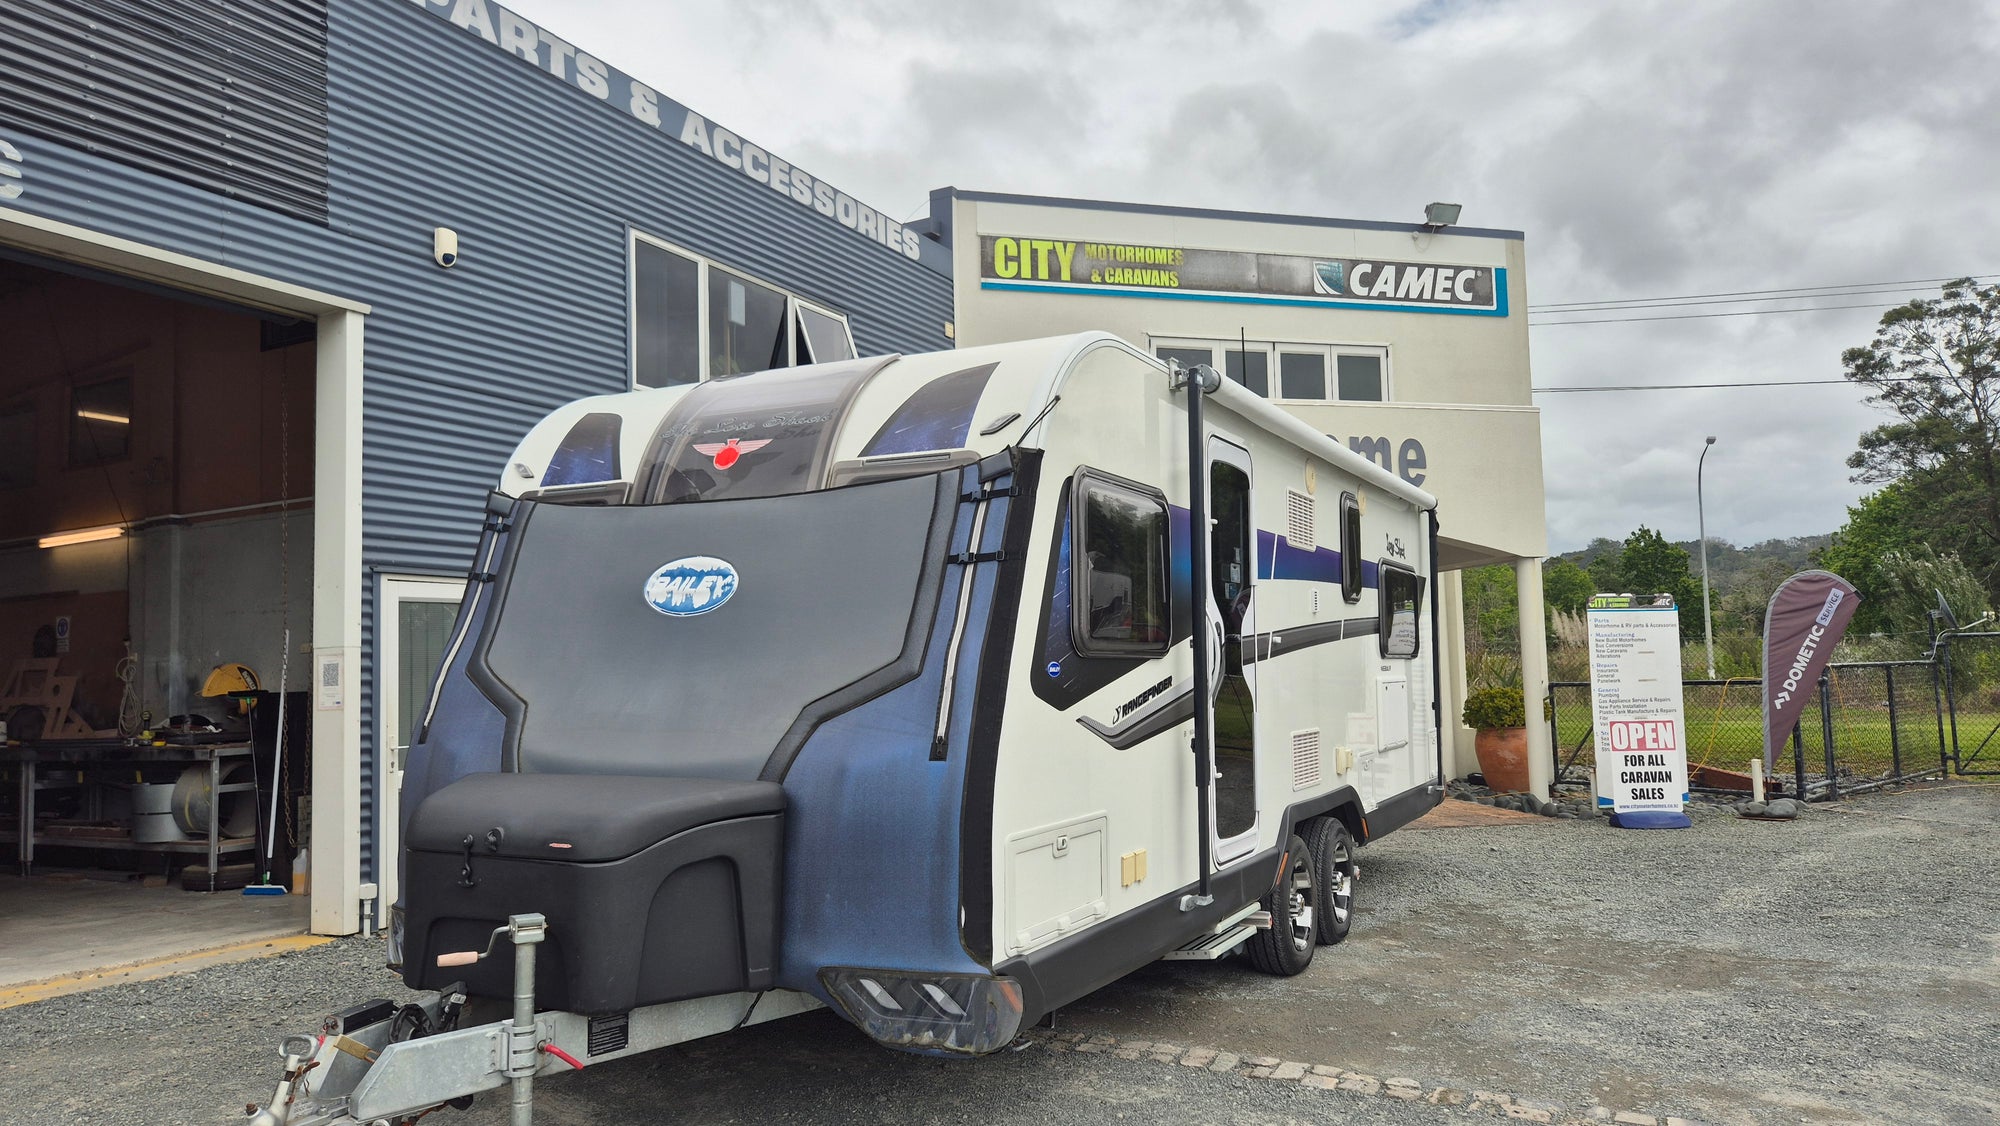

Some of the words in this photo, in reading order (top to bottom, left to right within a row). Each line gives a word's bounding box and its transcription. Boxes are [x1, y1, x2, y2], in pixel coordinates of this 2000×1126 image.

[412, 0, 609, 100] ARTS
[630, 80, 661, 128] &
[680, 110, 920, 261] ACCESSORIES
[994, 237, 1076, 281] CITY
[1085, 243, 1185, 266] MOTORHOMES
[1091, 269, 1102, 283] &
[1105, 268, 1179, 288] CARAVANS
[1350, 263, 1476, 302] CAMEC
[1782, 624, 1825, 692] DOMETIC
[1820, 592, 1840, 622] SERVICE
[1122, 675, 1173, 718] RANGEFINDER
[1611, 722, 1675, 750] OPEN
[1620, 771, 1672, 783] CARAVAN
[1624, 755, 1645, 767] FOR
[1648, 754, 1666, 766] ALL
[1631, 788, 1665, 800] SALES
